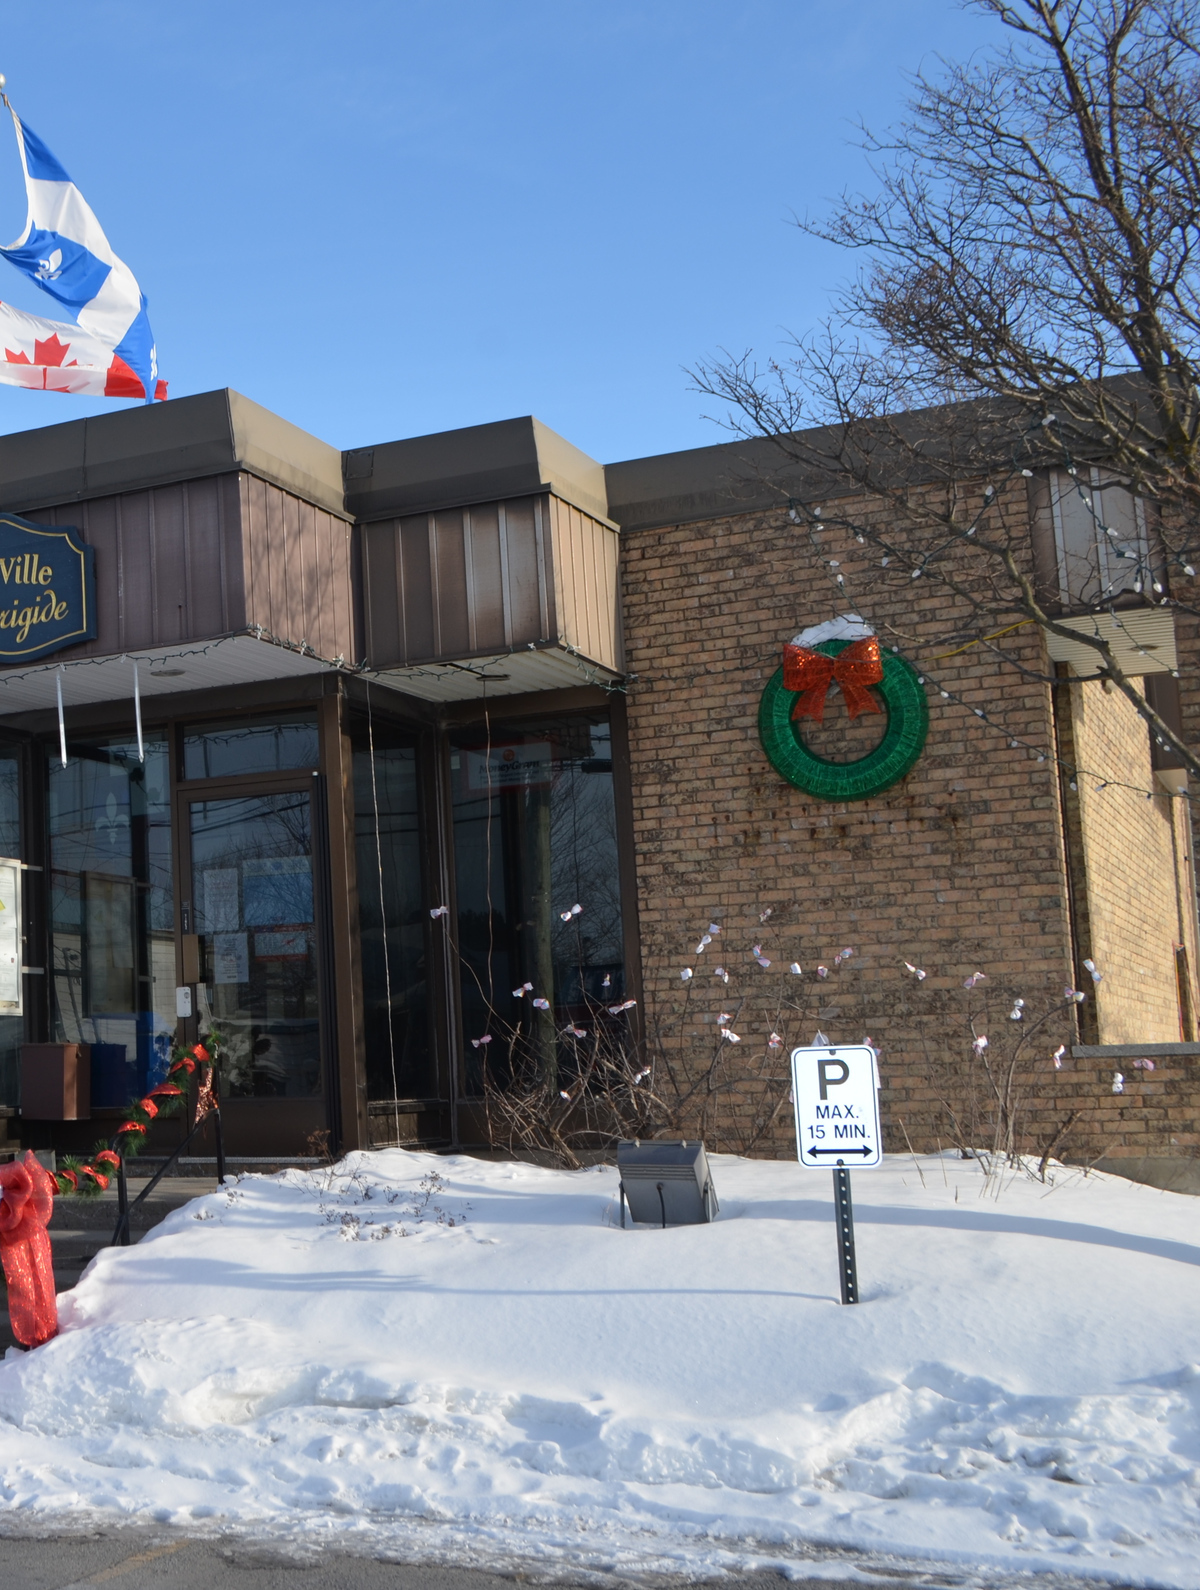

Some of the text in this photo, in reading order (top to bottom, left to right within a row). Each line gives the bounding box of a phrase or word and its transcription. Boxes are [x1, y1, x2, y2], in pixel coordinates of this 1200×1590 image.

[479, 760, 540, 774] MoneyGram
[817, 1059, 850, 1101] P
[815, 1105, 859, 1119] MAX.
[807, 1124, 871, 1139] 15 MIN.
